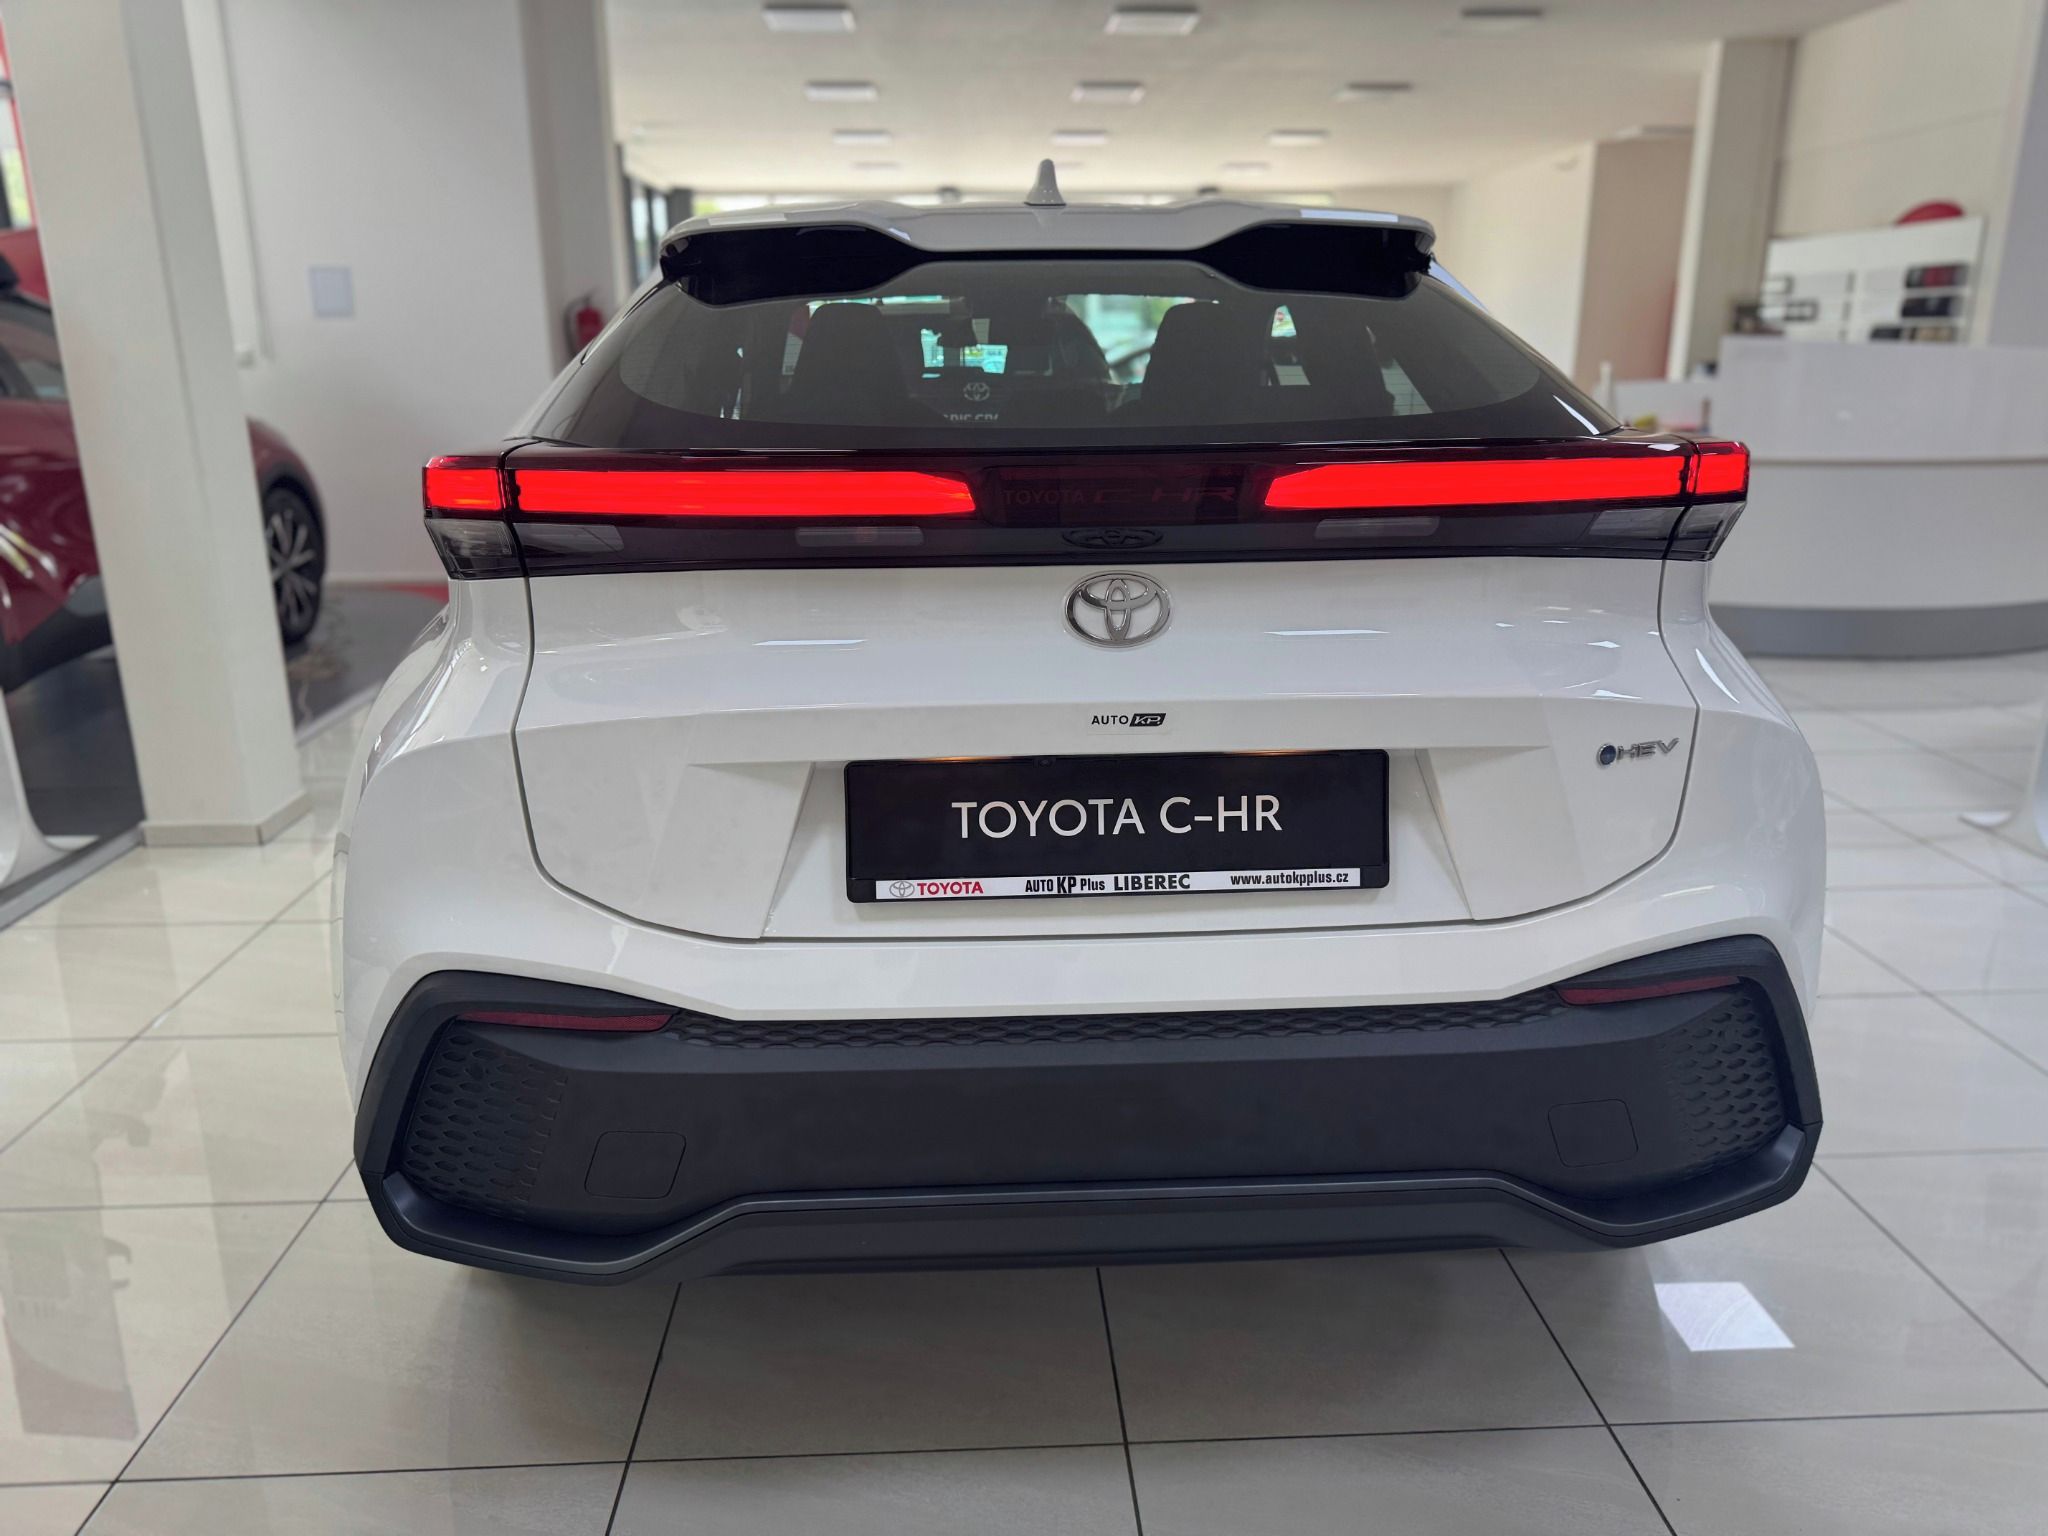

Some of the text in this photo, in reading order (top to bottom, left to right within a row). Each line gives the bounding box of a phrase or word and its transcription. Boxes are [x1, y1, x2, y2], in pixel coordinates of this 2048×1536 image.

[1003, 488, 1086, 505] TOYOTA
[1091, 714, 1129, 725] AUTO
[1617, 737, 1680, 761] HEV
[951, 794, 1284, 839] TOYOTA C-HR
[1024, 873, 1191, 894] AUTO KP Plus LIBEREC
[1230, 870, 1349, 886] www.autokpplus.cz
[916, 881, 984, 896] TOYOTA
